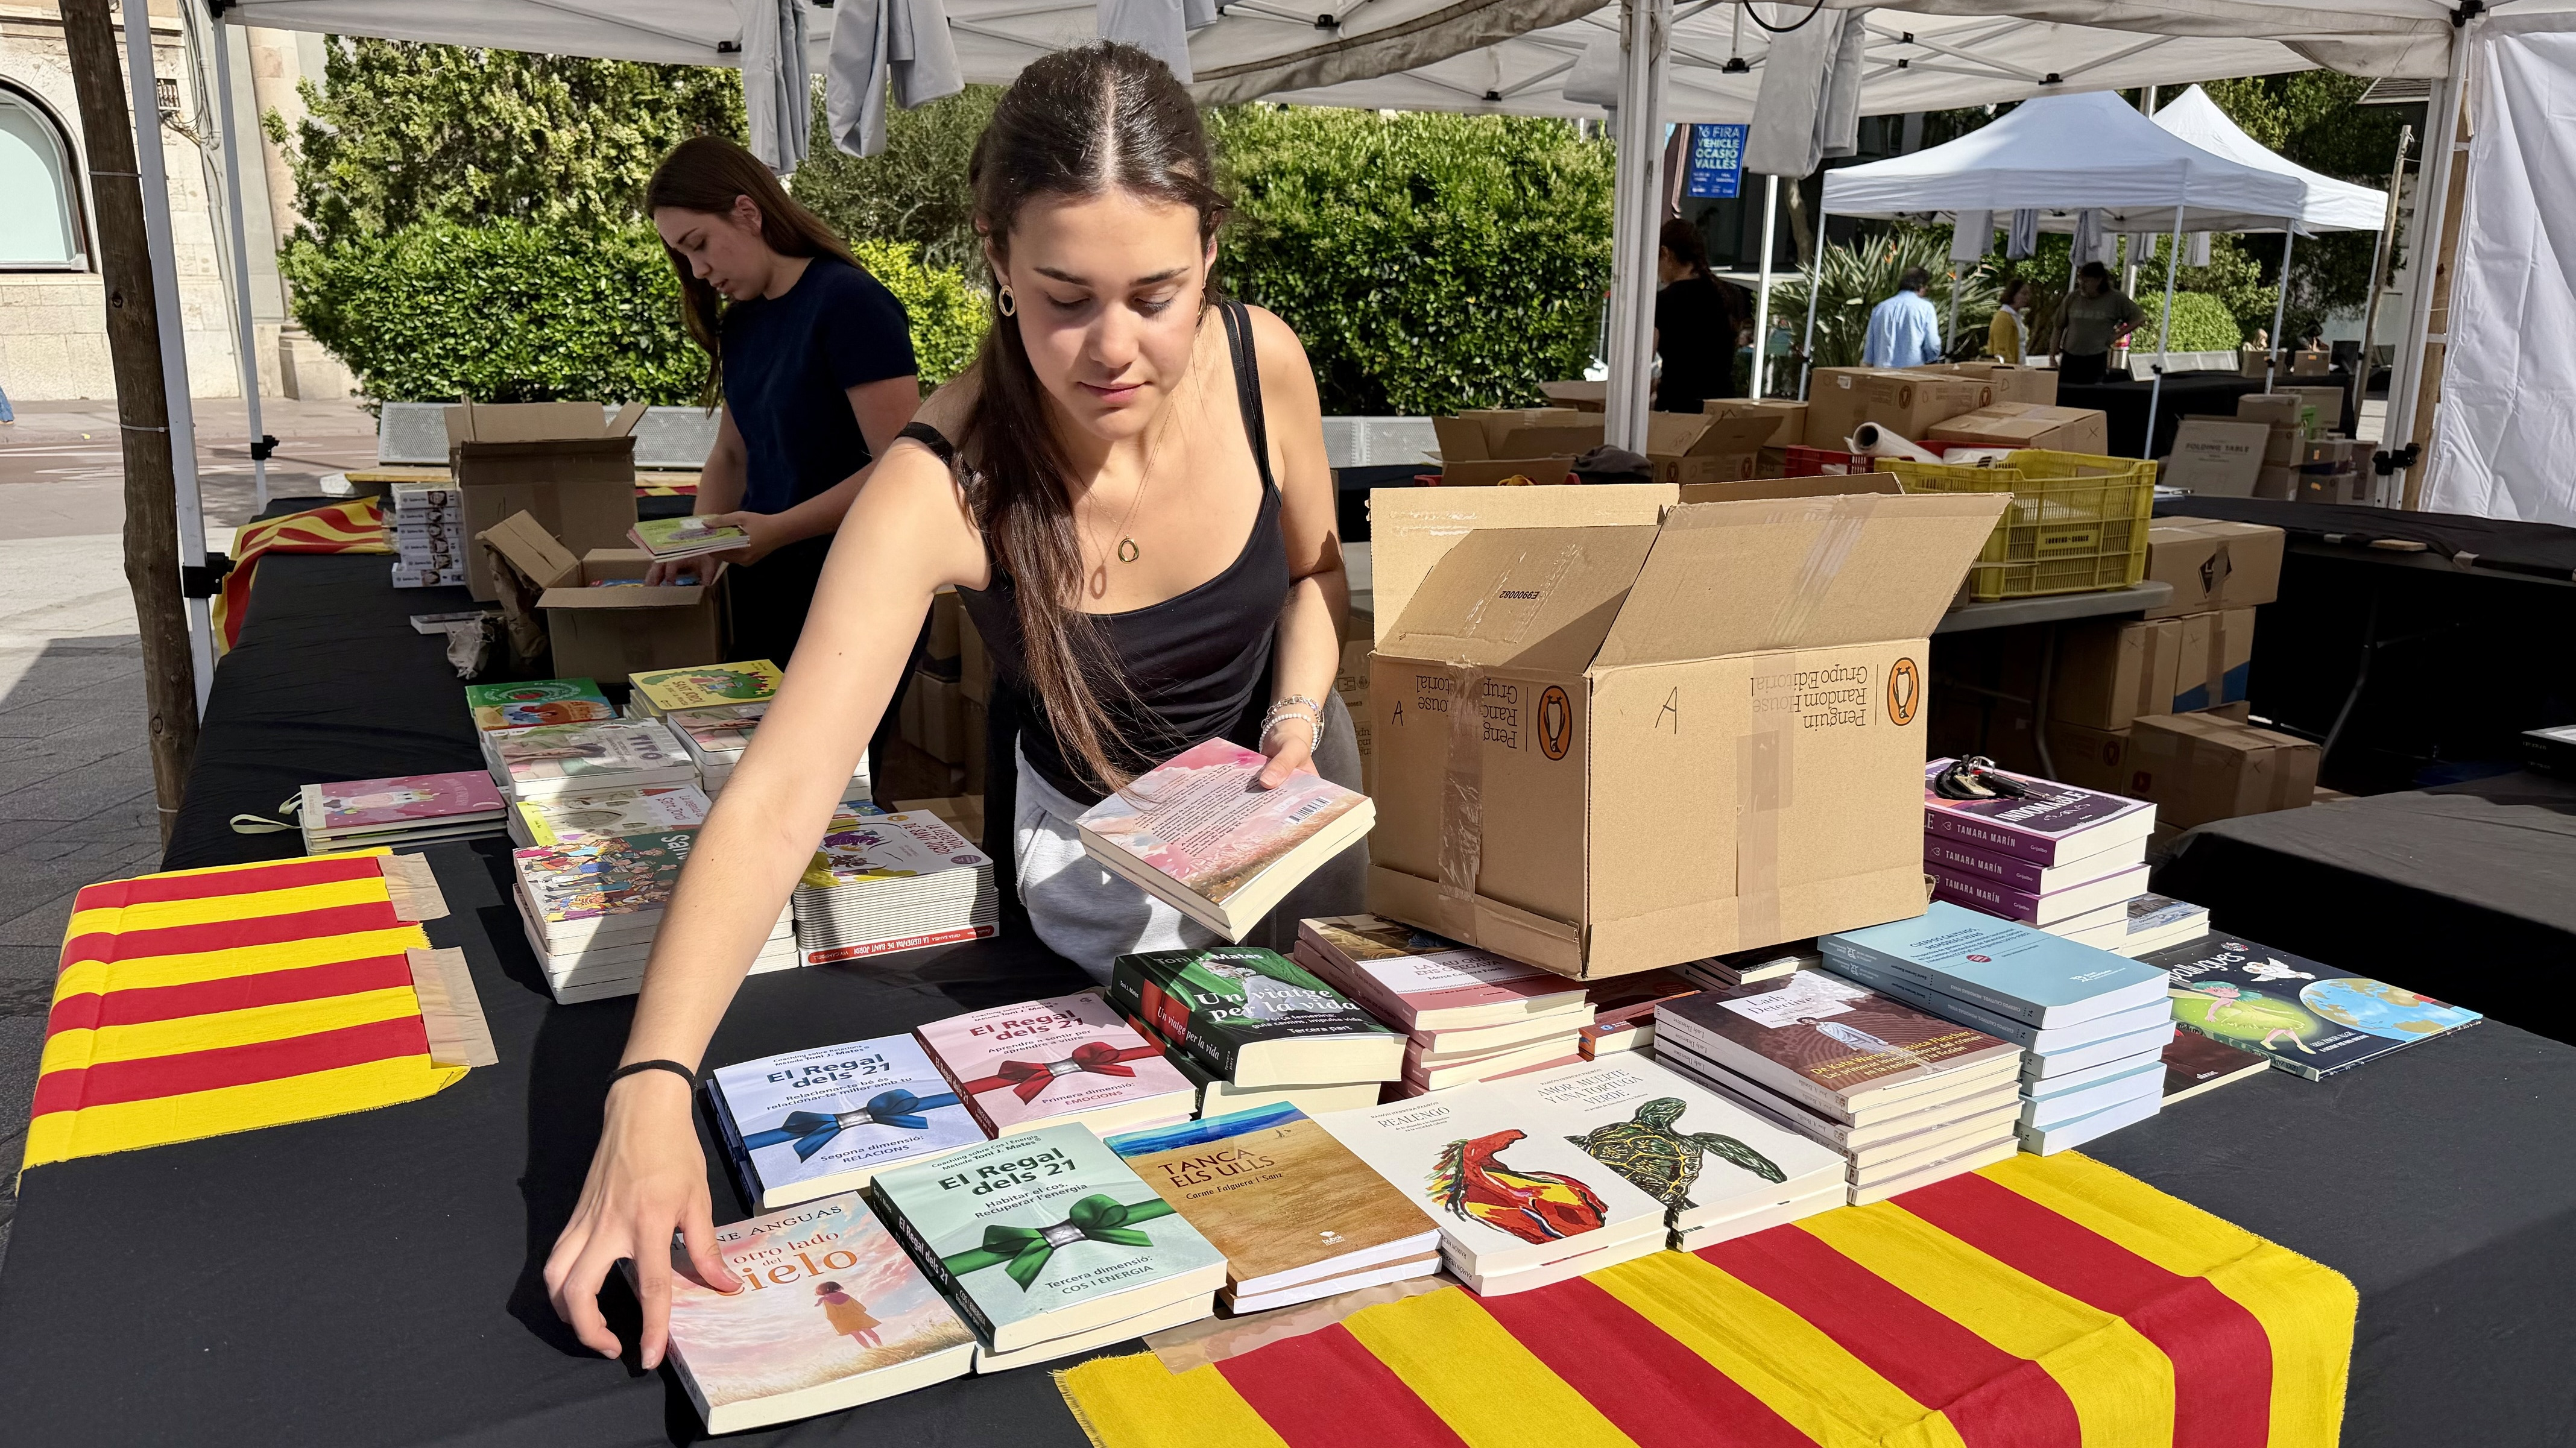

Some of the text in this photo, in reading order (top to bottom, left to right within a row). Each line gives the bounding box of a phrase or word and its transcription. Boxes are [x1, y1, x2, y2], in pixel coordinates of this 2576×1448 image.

[1698, 127, 1740, 138] 16 FIRA
[1696, 148, 1738, 159] OCASIÓ
[2185, 442, 2250, 453] FOLDING TABLE
[1499, 591, 1540, 599] E9900082
[1750, 664, 1868, 697] Grupo Editorial
[1655, 686, 1678, 735] A
[1752, 687, 1867, 713] Random House
[1803, 708, 1867, 732] Penguin
[1994, 790, 2092, 822] INDOMABLE
[1957, 825, 2016, 848] TAMARA MARÍN
[2030, 845, 2048, 854] Grijalbo
[1945, 851, 2003, 875] TAMARA MARÍN
[854, 946, 870, 955] JORDI
[887, 942, 895, 951] DE
[896, 937, 922, 949] LLEGENDA
[1153, 956, 1193, 965] Toni
[1213, 952, 1264, 961] Mates
[1442, 960, 1502, 972] OFEGAVA
[1194, 987, 1333, 1006] Un viatge
[1746, 995, 1785, 1006] Lady
[1747, 997, 1815, 1014] Detective
[970, 1010, 1076, 1036] El Regal
[1208, 999, 1360, 1023] per la vida
[996, 1018, 1084, 1040] dels 21
[1158, 1006, 1220, 1060] Un viatge per la vida
[988, 1040, 1034, 1053] Aprendre
[1045, 1033, 1072, 1041] sentir
[1810, 1066, 1828, 1075] De
[1831, 1059, 1855, 1070] Kate
[1856, 1051, 1887, 1064] Warne
[1898, 1041, 1931, 1053] Jessica
[1930, 1031, 1974, 1047] Fletcher.
[767, 1054, 884, 1083] El Regal
[1823, 1071, 1840, 1079] Las
[1840, 1062, 1880, 1076] primeras
[1954, 1035, 1983, 1045] crimen
[1886, 1057, 1922, 1071] realidad
[1939, 1046, 1968, 1056] ficción
[792, 1062, 890, 1088] dels 21
[935, 1057, 968, 1104] El Regal dels 21
[1537, 1069, 1629, 1097] AMOR, MUERTE
[767, 1093, 836, 1110] relacionar-te
[839, 1086, 873, 1095] millor
[786, 1083, 857, 1101] Relacionar-te
[1041, 1083, 1135, 1104] Primera dimensió:
[1065, 1090, 1123, 1106] EMOCIONS
[1556, 1092, 1586, 1101] UNA
[1582, 1076, 1644, 1095] TORTUGA
[1583, 1089, 1630, 1104] VERDE
[1378, 1107, 1450, 1127] REALENGO
[821, 1136, 924, 1162] Segona dimensió:
[843, 1145, 909, 1163] RELACIONS
[932, 1155, 967, 1168] Coaching
[1010, 1135, 1038, 1144] Energia
[938, 1148, 1065, 1191] El Regal
[1158, 1148, 1255, 1177] TANCA
[1170, 1155, 1275, 1189] ELS ULLS
[971, 1159, 1076, 1195] dels 21
[975, 1184, 1088, 1218] Recuperar l'energia
[985, 1191, 1029, 1208] Habitar
[750, 1206, 842, 1236] ANGUAS
[733, 1232, 839, 1265] otro lado
[899, 1216, 949, 1285] El Regal dels 21
[715, 1250, 857, 1296] ielo
[763, 1258, 781, 1267] del
[1045, 1255, 1153, 1289] Tercera dimensió:
[1062, 1283, 1088, 1294] COS
[1097, 1265, 1154, 1285] ENERGIA
